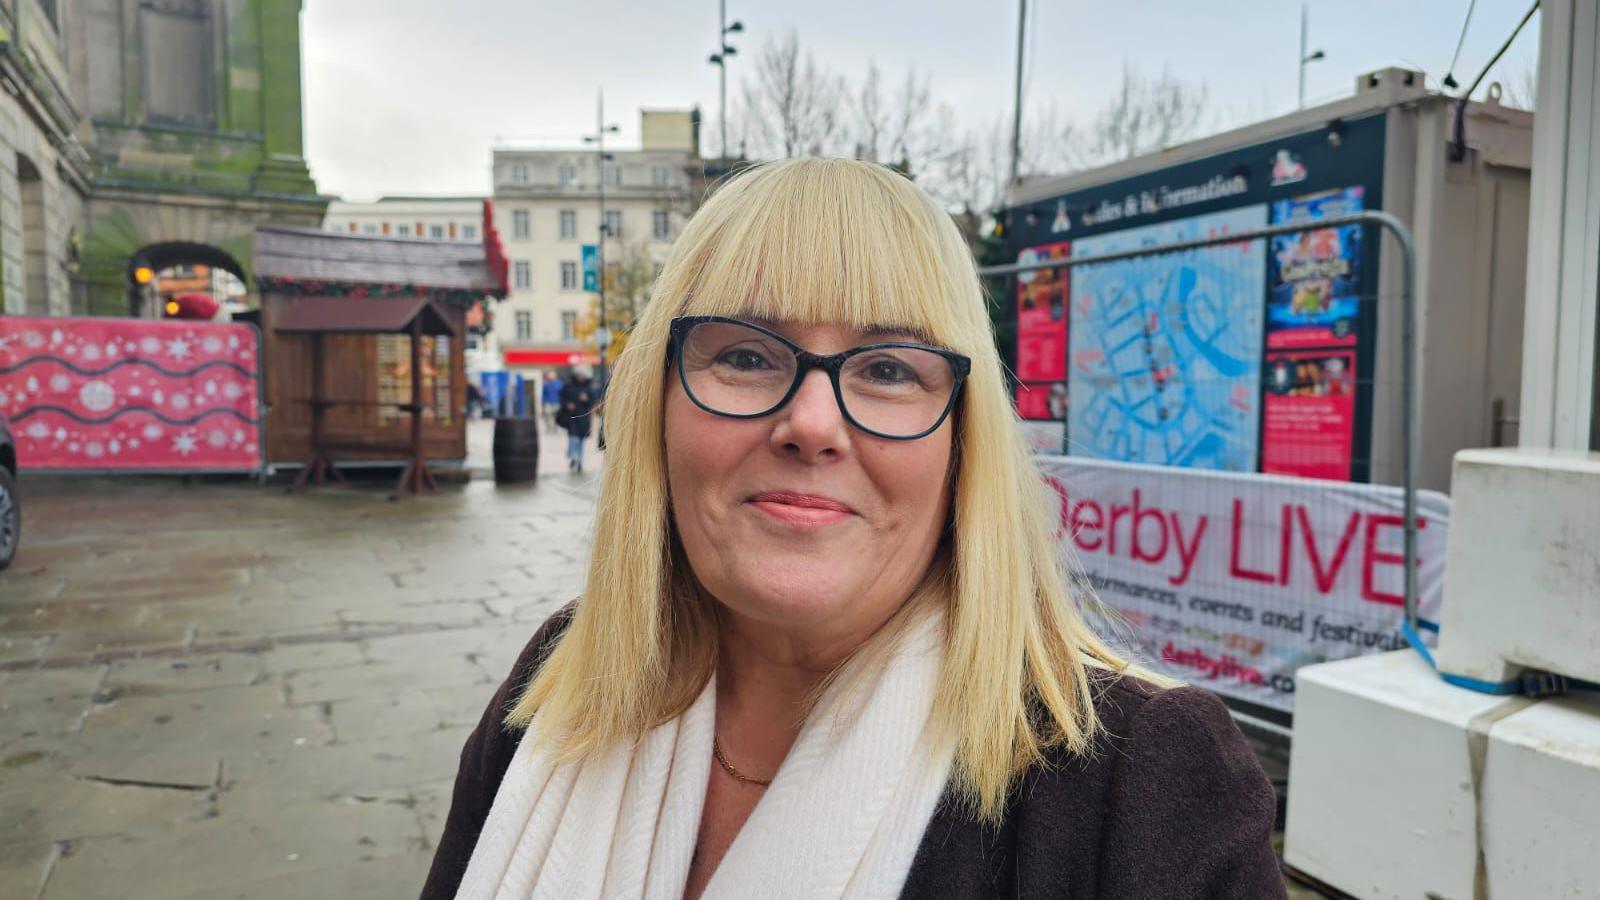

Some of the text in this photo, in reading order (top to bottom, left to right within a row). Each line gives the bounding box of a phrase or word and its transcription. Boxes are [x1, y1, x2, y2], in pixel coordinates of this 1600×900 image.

[1229, 498, 1428, 608] LIVE
[1190, 596, 1254, 622] events
[1261, 609, 1304, 633] and
